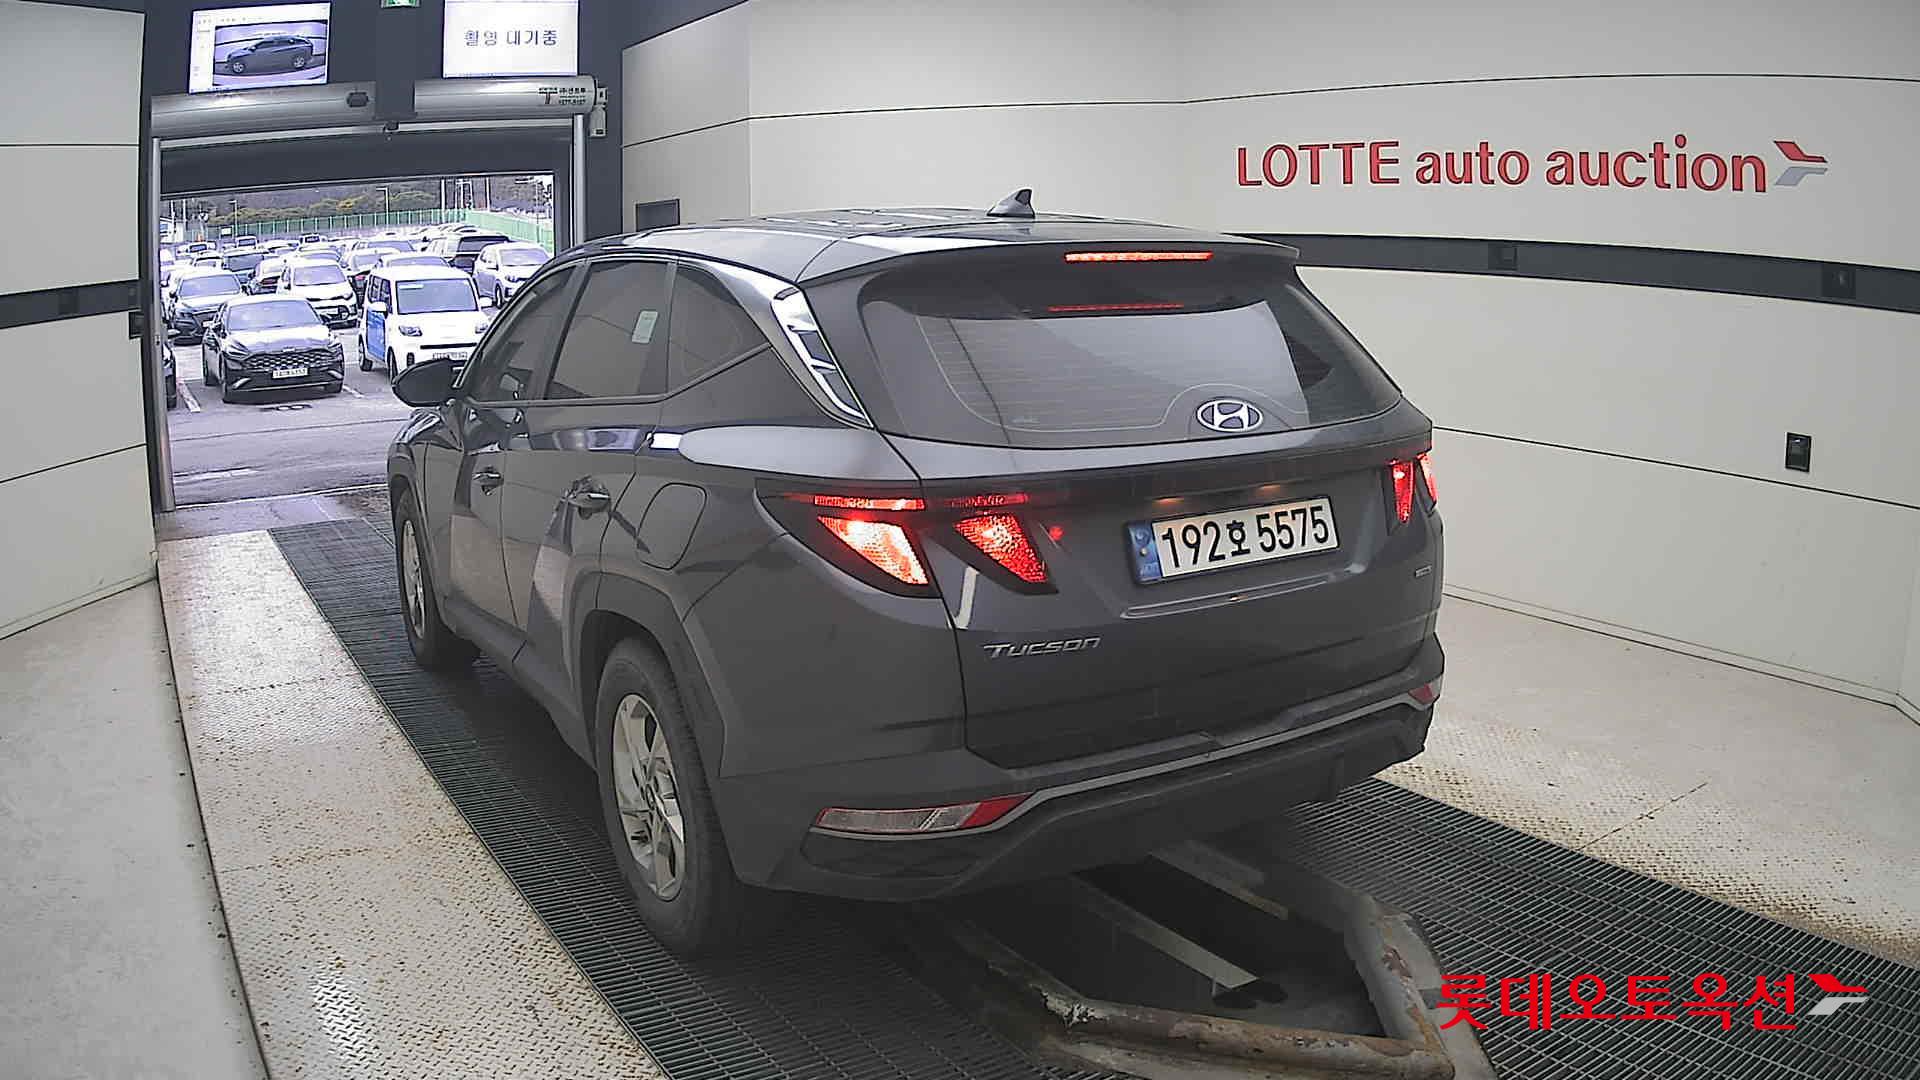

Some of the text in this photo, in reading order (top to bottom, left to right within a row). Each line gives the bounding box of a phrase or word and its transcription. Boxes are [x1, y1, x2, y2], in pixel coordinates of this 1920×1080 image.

[506, 30, 558, 46] 대기중
[1237, 134, 1767, 193] LOTTE auto auction
[1161, 505, 1330, 569] 192호 5575
